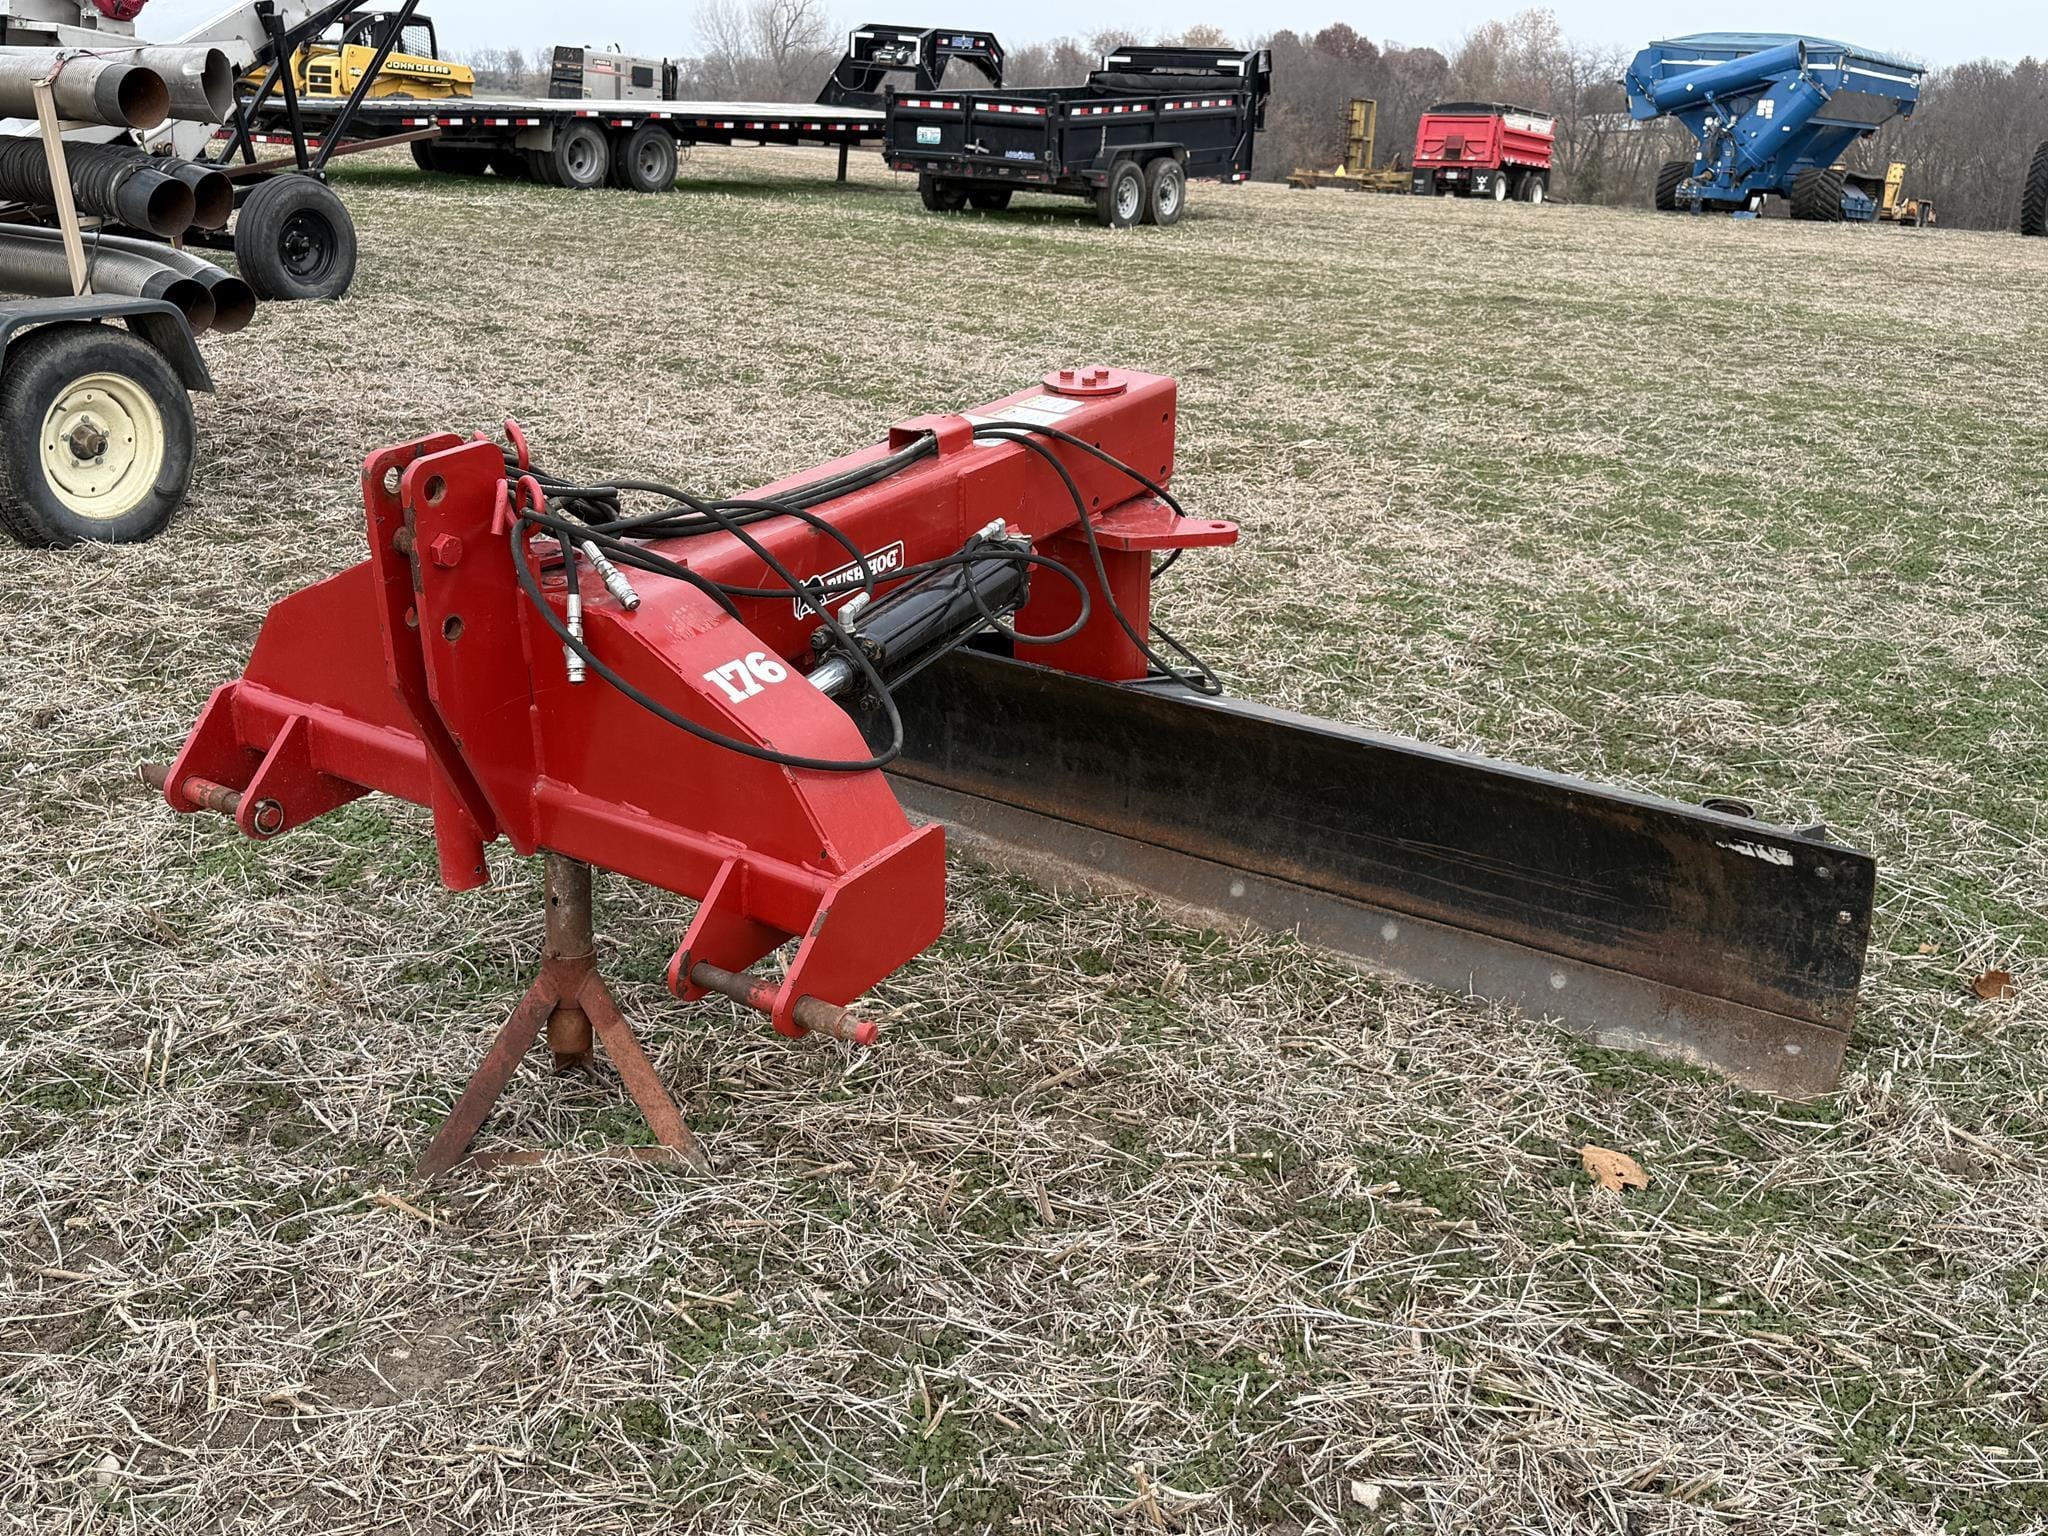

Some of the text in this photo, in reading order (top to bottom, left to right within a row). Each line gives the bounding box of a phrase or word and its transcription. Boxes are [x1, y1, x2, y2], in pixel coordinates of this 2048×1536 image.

[386, 61, 449, 74] JOHN DEERE
[702, 651, 788, 704] 176
